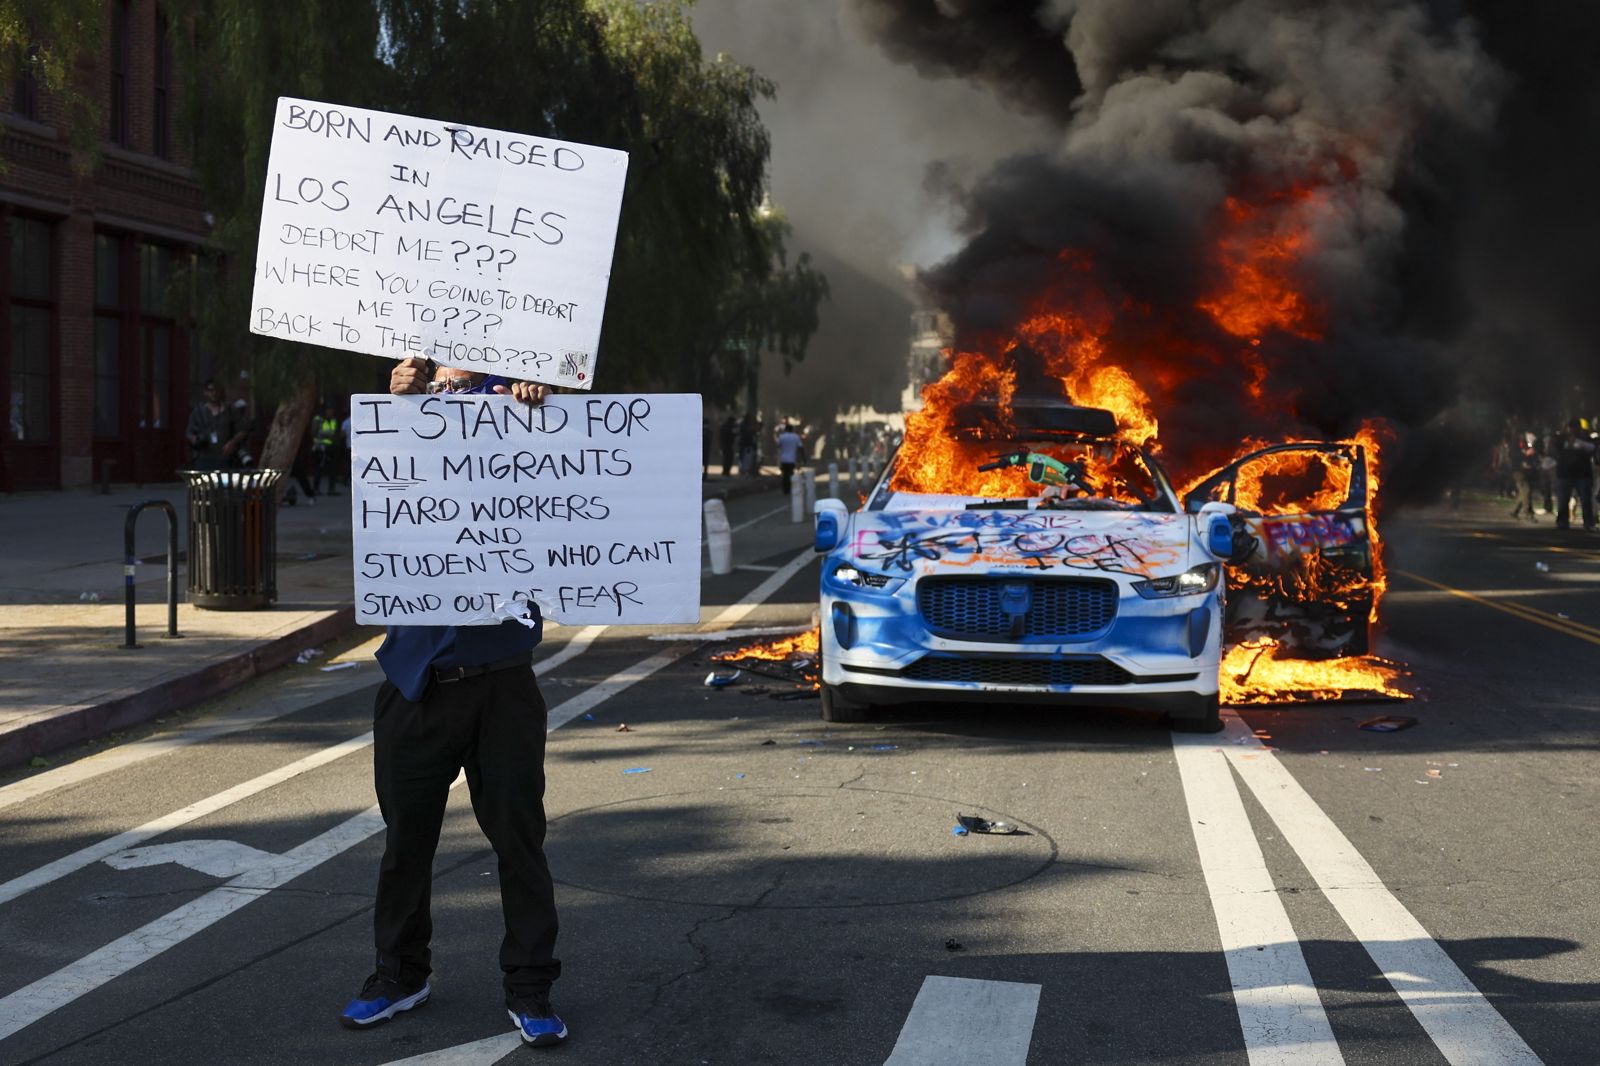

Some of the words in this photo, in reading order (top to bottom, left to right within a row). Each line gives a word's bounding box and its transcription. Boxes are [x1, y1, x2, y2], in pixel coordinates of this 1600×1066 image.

[283, 105, 371, 143] BORN
[383, 124, 441, 148] AND
[443, 126, 585, 172] RAISED
[389, 164, 430, 188] IN
[275, 173, 350, 212] LOS
[376, 194, 567, 245] ANGELES
[279, 223, 385, 255] DEPORT
[397, 236, 518, 281] ME???
[264, 257, 360, 288] WHERE
[375, 270, 420, 295] YOU
[428, 280, 494, 307] GOING
[498, 289, 518, 311] TO
[523, 293, 579, 323] DEPORT
[357, 299, 393, 318] ME
[405, 302, 503, 339] TO???
[253, 306, 322, 335] BACK
[374, 325, 422, 353] THE
[433, 339, 553, 377] HOOD???
[355, 400, 399, 435] I
[411, 397, 569, 440] STAND
[585, 397, 651, 438] FOR
[361, 455, 428, 482] ALL
[442, 448, 632, 484] MIGRANTS
[362, 496, 460, 529] HARD
[471, 495, 611, 522] WORKERS
[455, 527, 522, 546] AND
[361, 548, 535, 579] STUDENTS
[548, 544, 602, 568] WHO
[608, 540, 676, 565] CANT
[1021, 555, 1140, 576] ICE
[361, 592, 442, 618] STAND
[453, 592, 501, 613] OUT
[558, 581, 644, 617] FEAR
